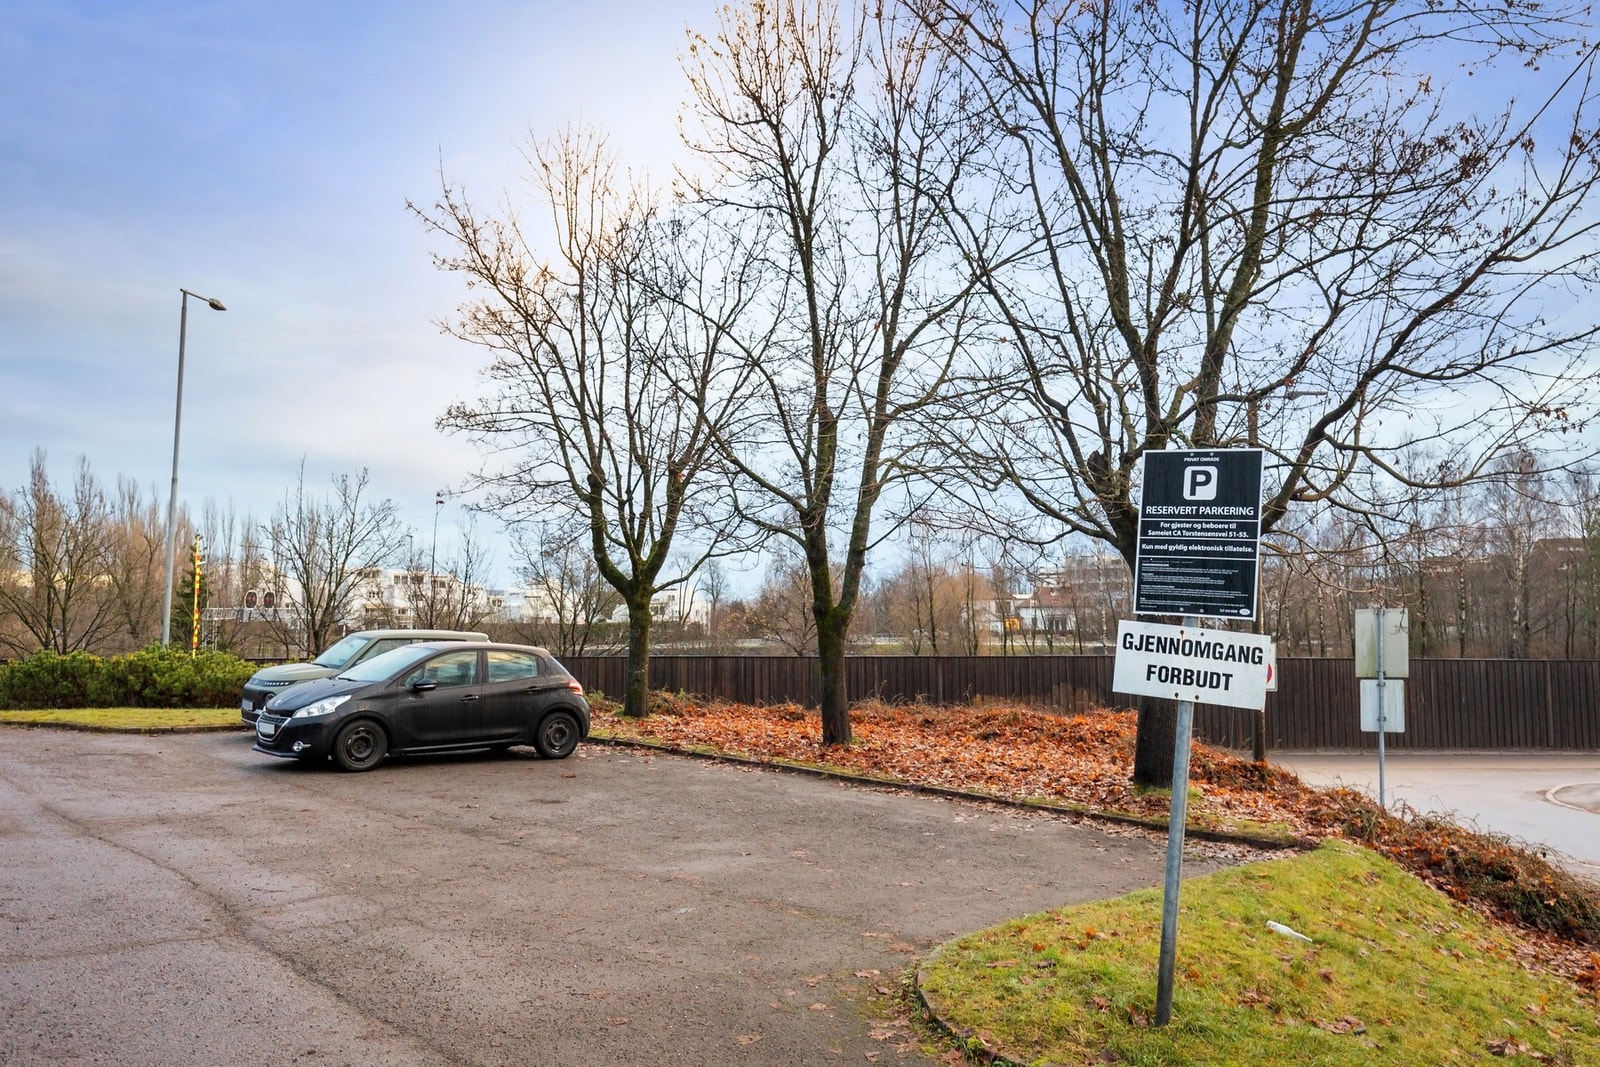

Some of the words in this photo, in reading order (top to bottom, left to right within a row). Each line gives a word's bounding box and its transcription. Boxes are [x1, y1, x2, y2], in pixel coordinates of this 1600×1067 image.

[1189, 470, 1212, 496] P
[1146, 506, 1198, 515] RESERVERT
[1200, 506, 1254, 516] PARKERING
[1171, 521, 1193, 529] gjester
[1168, 544, 1188, 552] gyldig
[1122, 632, 1264, 665] GJENNOMGANG
[1146, 664, 1233, 691] FORBUDT
